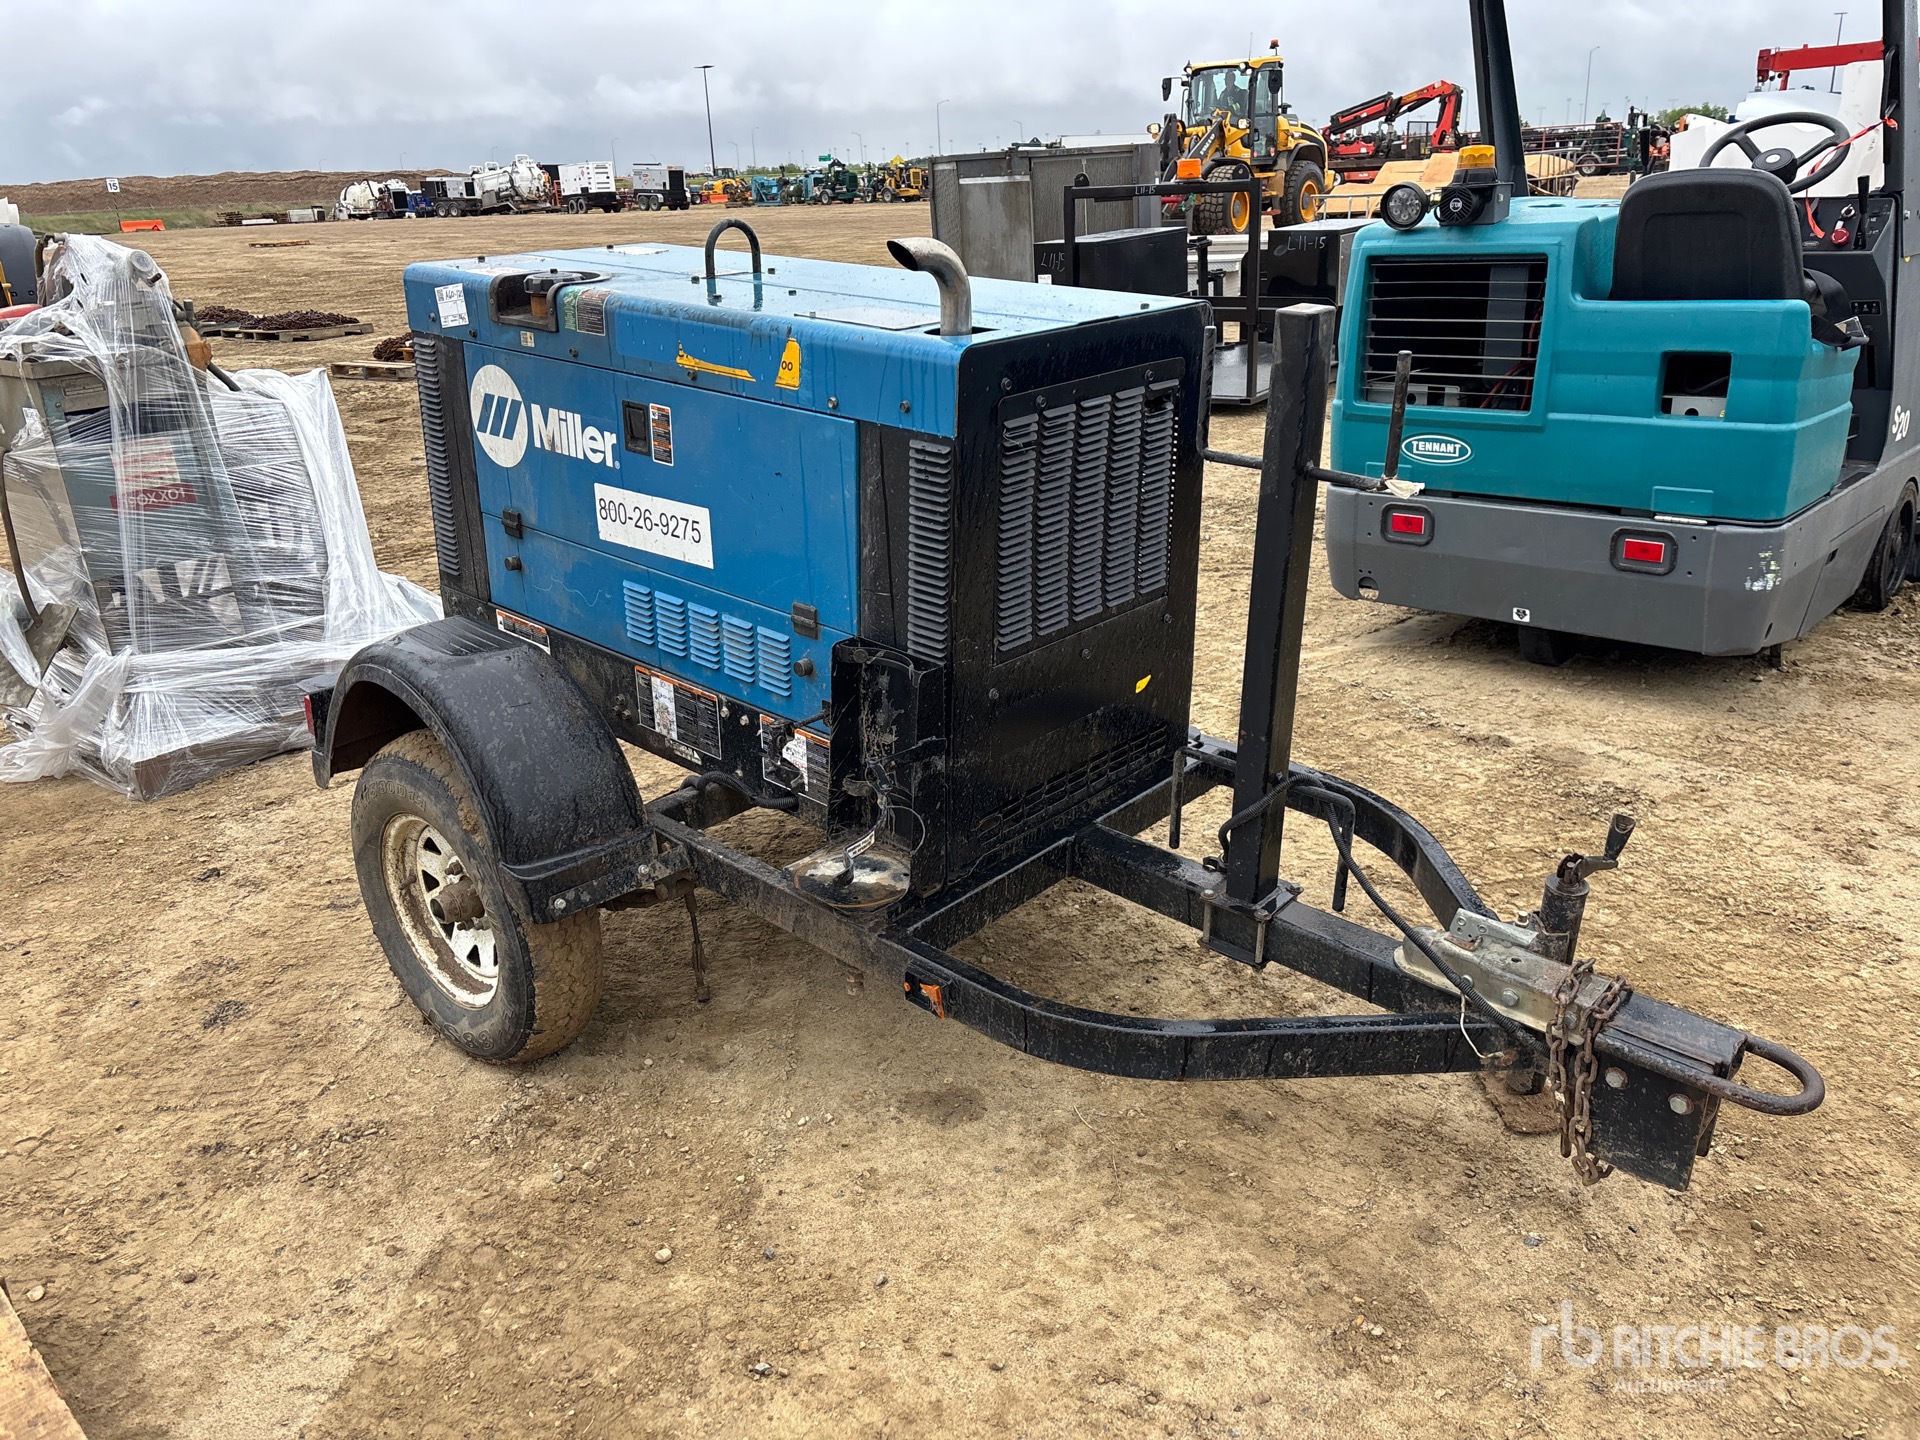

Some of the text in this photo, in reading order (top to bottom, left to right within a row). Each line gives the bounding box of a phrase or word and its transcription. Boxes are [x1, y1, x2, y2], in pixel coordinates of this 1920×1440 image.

[108, 182, 118, 191] 15
[1287, 235, 1327, 252] L11-15
[530, 403, 618, 468] Miller
[1411, 440, 1462, 457] TENNANT
[598, 497, 702, 544] 800-26-9275
